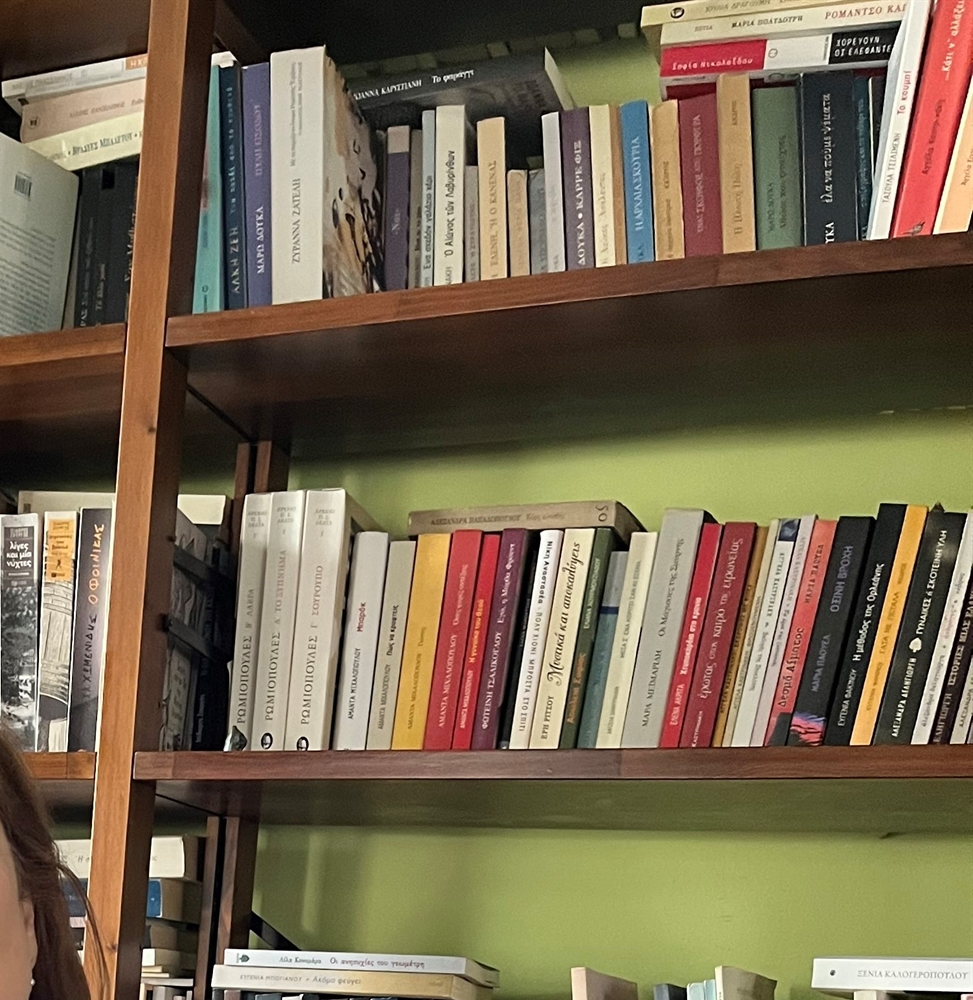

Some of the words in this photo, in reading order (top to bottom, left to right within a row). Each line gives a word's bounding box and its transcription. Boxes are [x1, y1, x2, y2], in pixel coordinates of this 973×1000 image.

[731, 19, 755, 28] ΜΑΡΙΑ
[824, 6, 883, 20] ΡΟΜΑΝΤΣΟ
[573, 140, 582, 164] ΦΙΞ
[291, 178, 302, 217] ΖΑΤΕΛΗ
[574, 166, 584, 209] ΚΑΡΡΕ
[228, 225, 240, 252] ΖΕΗ
[254, 206, 265, 242] ΔΟΥΚΑ
[291, 220, 302, 264] ΖΥΡΑΝΝΑ
[575, 222, 586, 266] ΔΟΥΚΑ
[255, 244, 266, 275] ΜΑΡΩ
[542, 540, 553, 561] Νίκη
[836, 545, 853, 579] ΒΡΟΧΗ
[537, 561, 549, 605] Αναστασέα
[561, 541, 584, 610] αποκαλύψεις
[914, 597, 932, 635] ΓΥΝΑΙΚΕΣ
[924, 548, 943, 589] ΣΚΟΤΕΙΝΗ
[829, 581, 845, 612] ΟΞΙΝΗ
[559, 611, 570, 631] και
[301, 635, 318, 725] ΡΩΜΙΟΠΟΥΛΕΣ
[312, 564, 324, 616] ΣΟΥΡΟΥΠΟ
[546, 632, 565, 686] Μυστικά
[236, 636, 253, 724] ΡΩΜΙΟΠΟΥΛΕΣ
[264, 631, 281, 721] ΡΩΜΙΟΠΟΥΛΕΣ
[347, 695, 356, 720] ΑΜΑΝΤΑ
[438, 696, 449, 729] ΑΜΑΝΤΑ
[543, 695, 554, 722] ΡΙΤΣΟΥ
[641, 703, 652, 727] ΜΑΡΑ
[540, 723, 550, 740] ΕΡΗ
[857, 970, 883, 978] ΞΕΝΙΑ
[885, 970, 969, 980] ΚΑΛΟΓΕΡΟΠΟΥΛΟΥ
